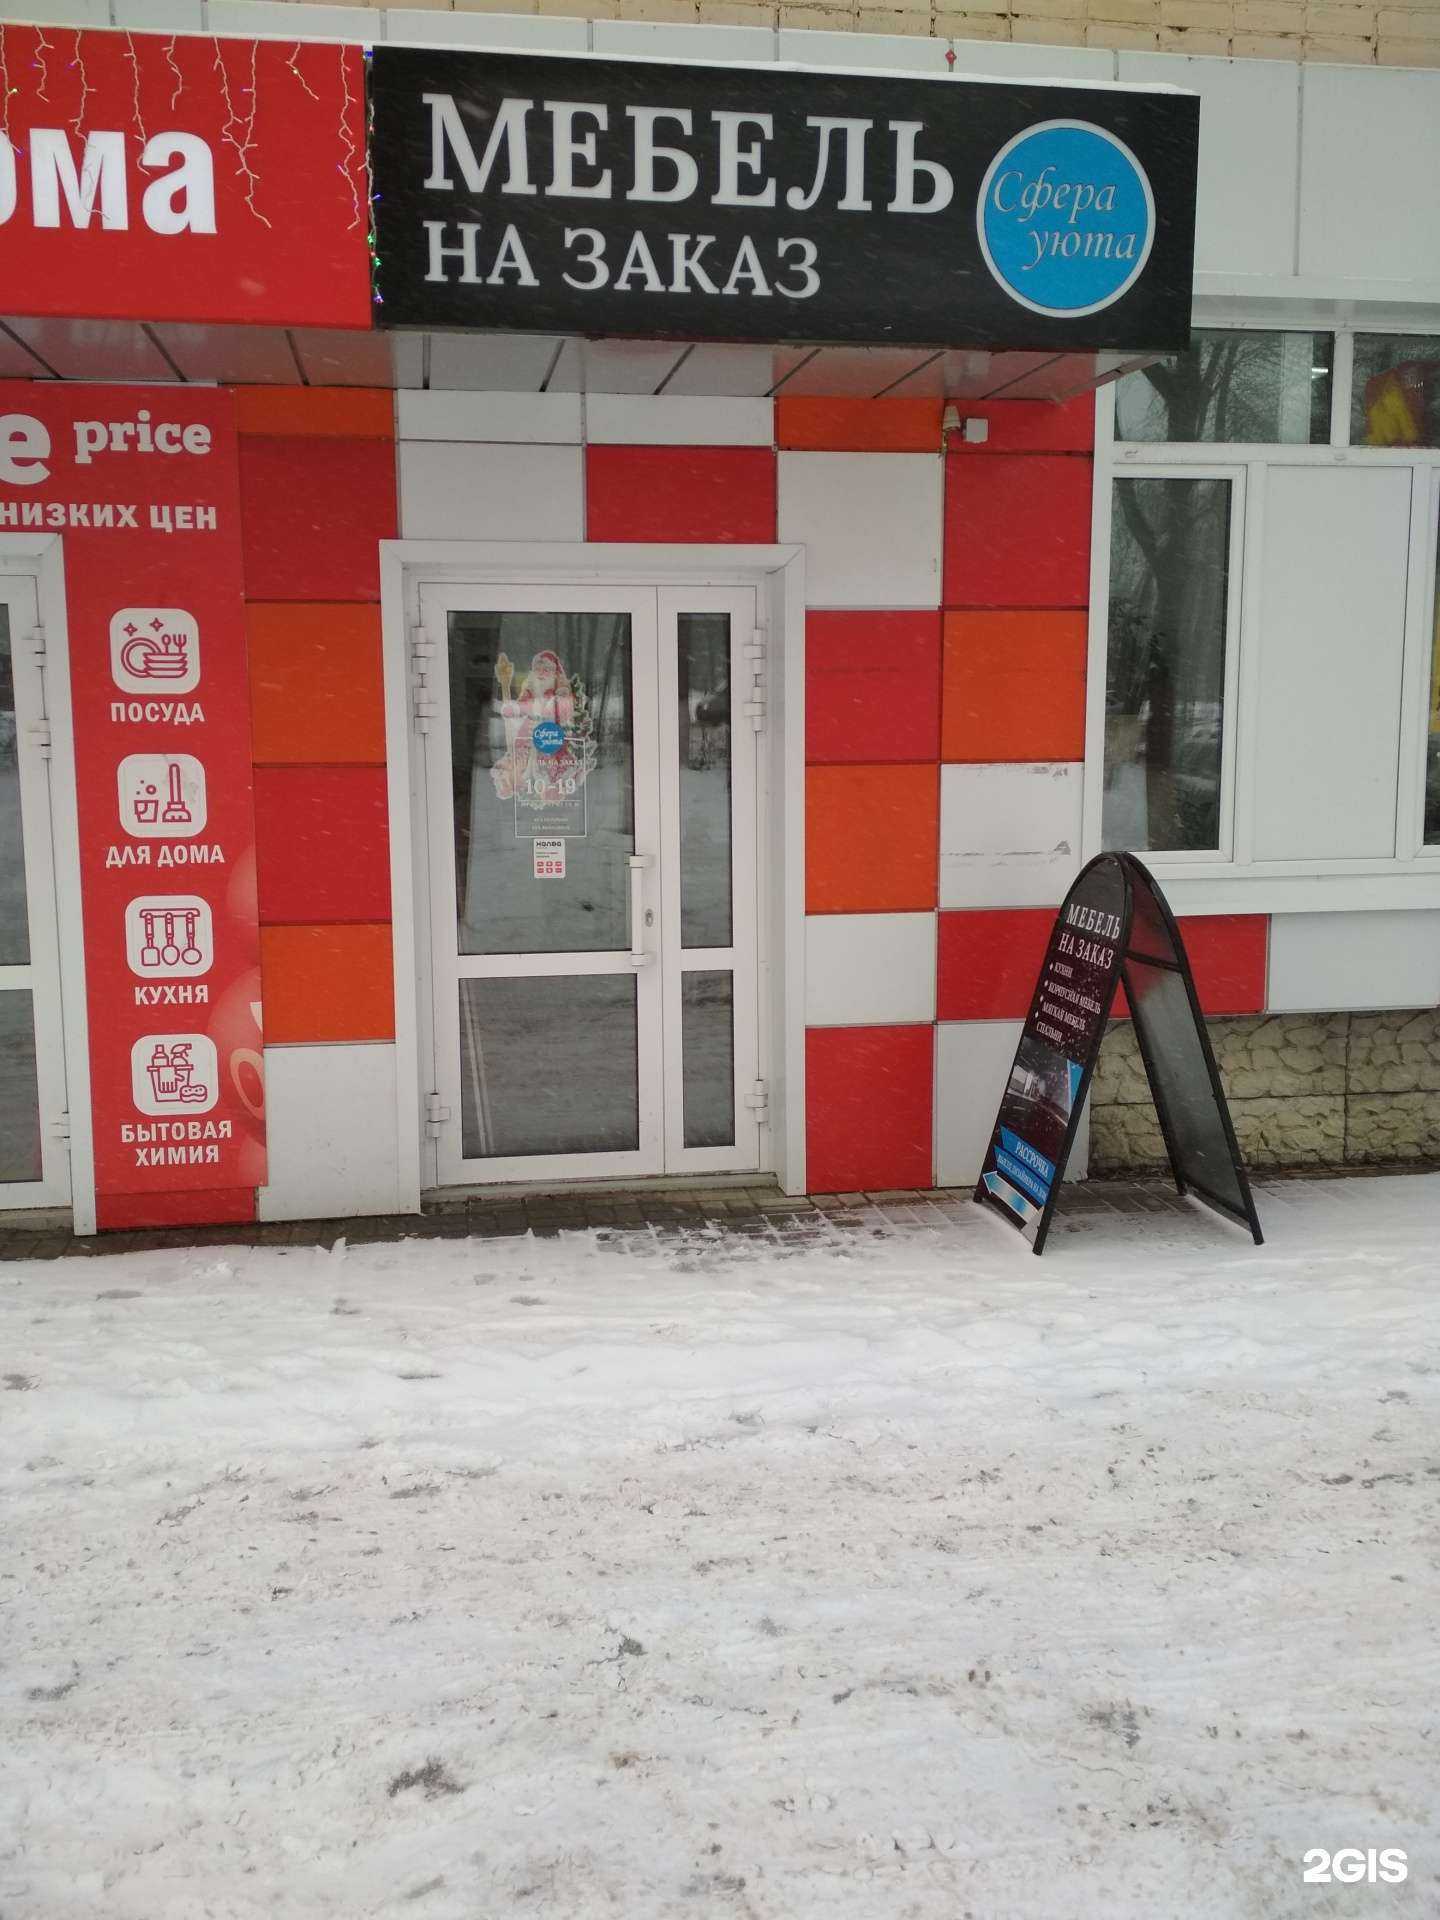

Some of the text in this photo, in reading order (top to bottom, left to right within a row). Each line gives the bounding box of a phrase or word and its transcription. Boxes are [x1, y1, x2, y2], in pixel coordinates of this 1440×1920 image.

[422, 91, 954, 215] МЕБЕЛЬ
[993, 166, 1117, 223] Сфера
[424, 220, 820, 299] НА ЗАКАЗ
[1023, 227, 1137, 271] уюта
[73, 409, 211, 464] price
[0, 502, 217, 533] НИЗКИХ ЦЕН
[110, 702, 205, 726] ПОСУДА
[106, 844, 225, 869] ДЛЯ ДОМА
[1066, 904, 1120, 940] МЕБЕЛЬ
[1058, 932, 1114, 969] НА ЗАКАЗ
[134, 984, 209, 1006] КУХНЯ
[121, 1119, 232, 1144] БЫТОВАЯ
[135, 1144, 219, 1167] ХИМИЯ
